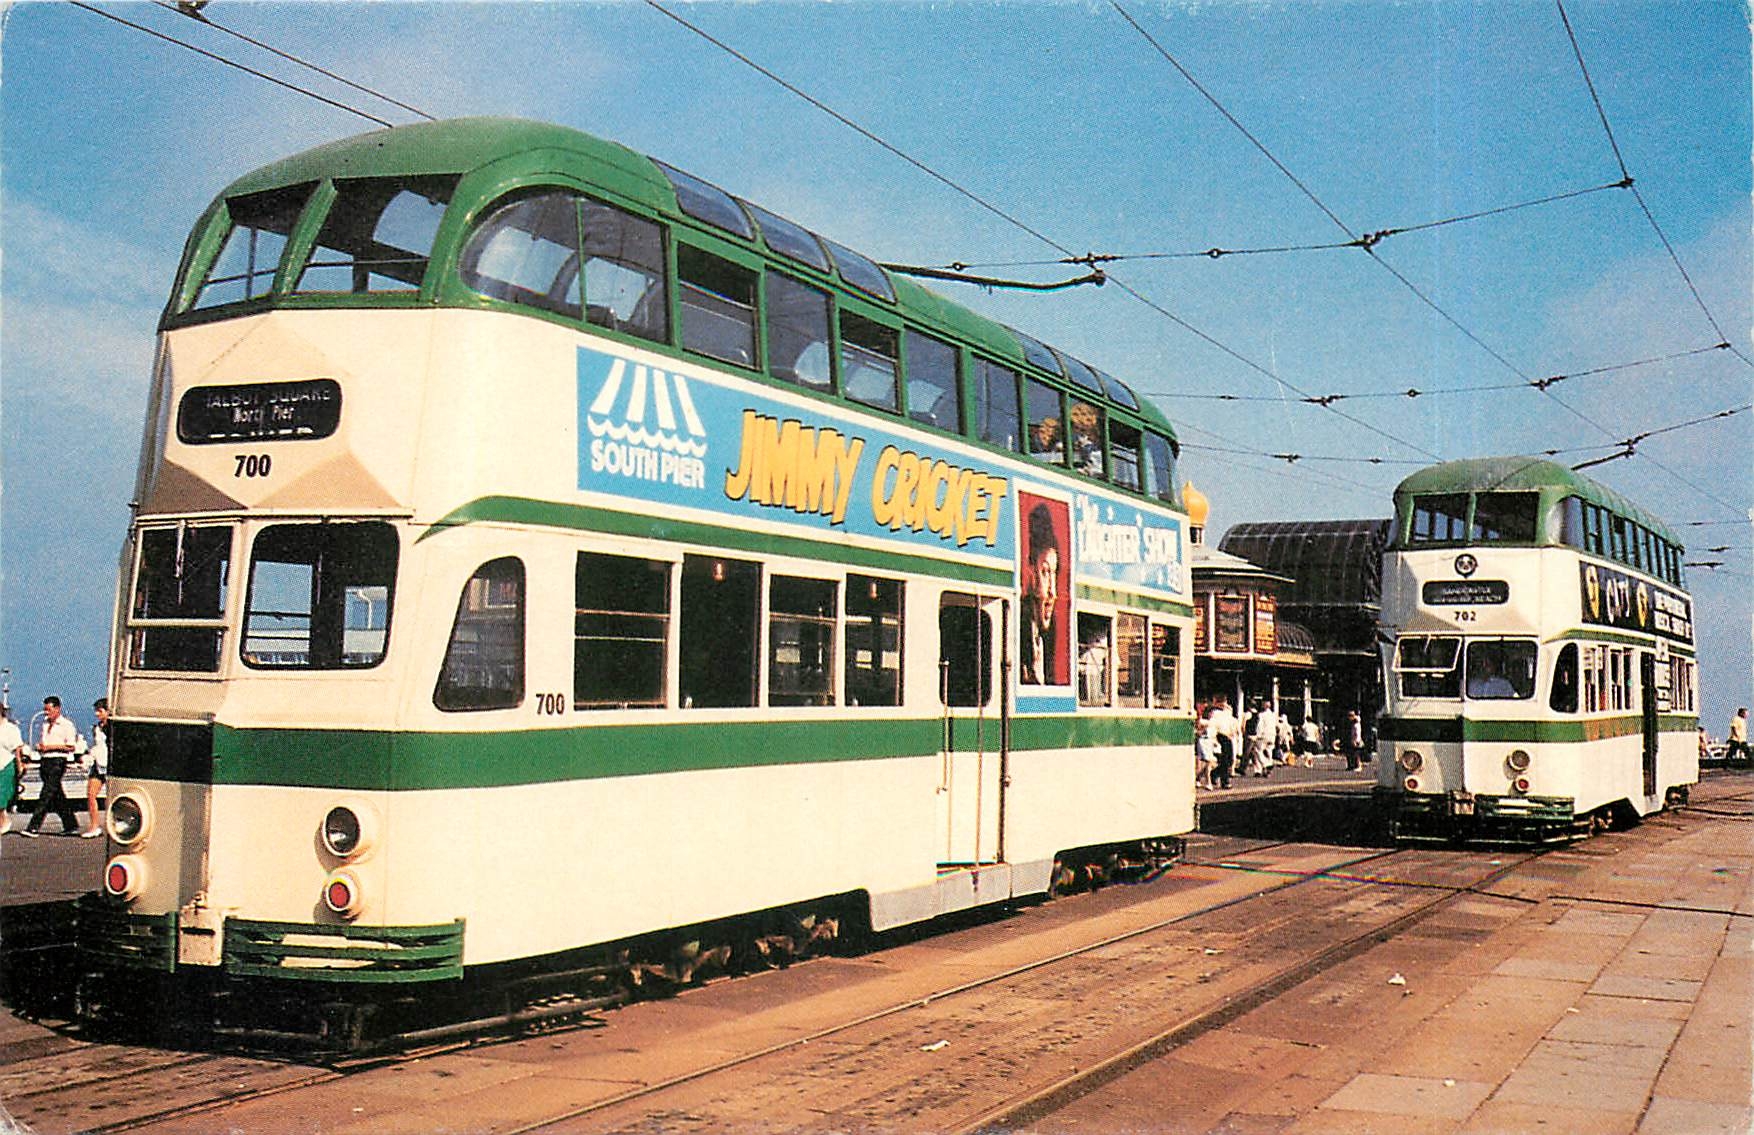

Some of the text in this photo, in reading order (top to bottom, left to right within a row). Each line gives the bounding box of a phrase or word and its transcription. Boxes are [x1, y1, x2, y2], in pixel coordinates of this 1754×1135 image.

[235, 454, 272, 478] 700
[590, 437, 706, 490] SOUTH PIER
[725, 408, 1009, 547] JIMMY CRICKET
[1453, 610, 1477, 622] 702
[535, 693, 565, 716] 700
